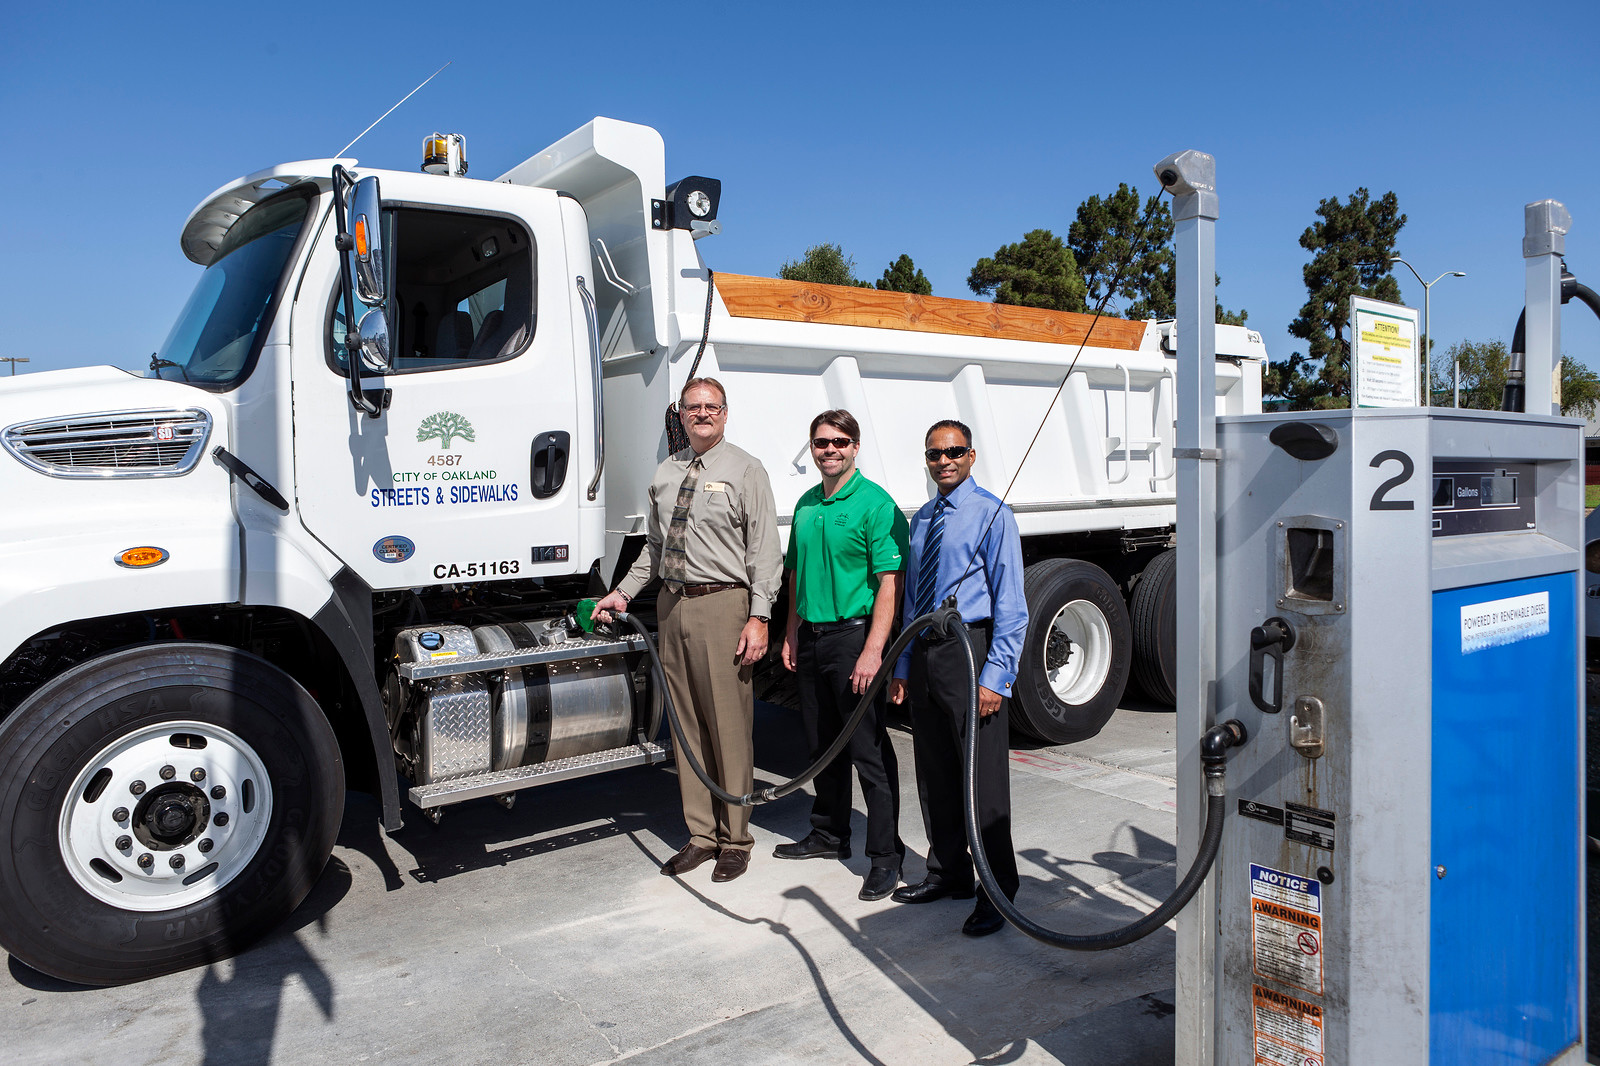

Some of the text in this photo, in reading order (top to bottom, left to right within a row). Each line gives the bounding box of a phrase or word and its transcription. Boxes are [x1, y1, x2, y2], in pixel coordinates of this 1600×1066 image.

[1375, 323, 1399, 335] ATTENTION!
[158, 427, 173, 439] SD
[427, 454, 463, 467] 4587
[392, 470, 497, 483] CITY OF OAKLAND
[1369, 449, 1414, 511] 2
[371, 483, 518, 508] STREETS & SIDEWALKS
[1457, 487, 1479, 498] Gallons
[533, 547, 567, 561] 114 SD
[433, 560, 520, 579] CA-51163
[1464, 604, 1546, 630] POWERED BY RENEWABLE DIESEL
[99, 693, 170, 732] HSA
[1259, 870, 1309, 892] NOTICE
[1261, 902, 1319, 929] WARNING
[1262, 988, 1320, 1017] WARNING
